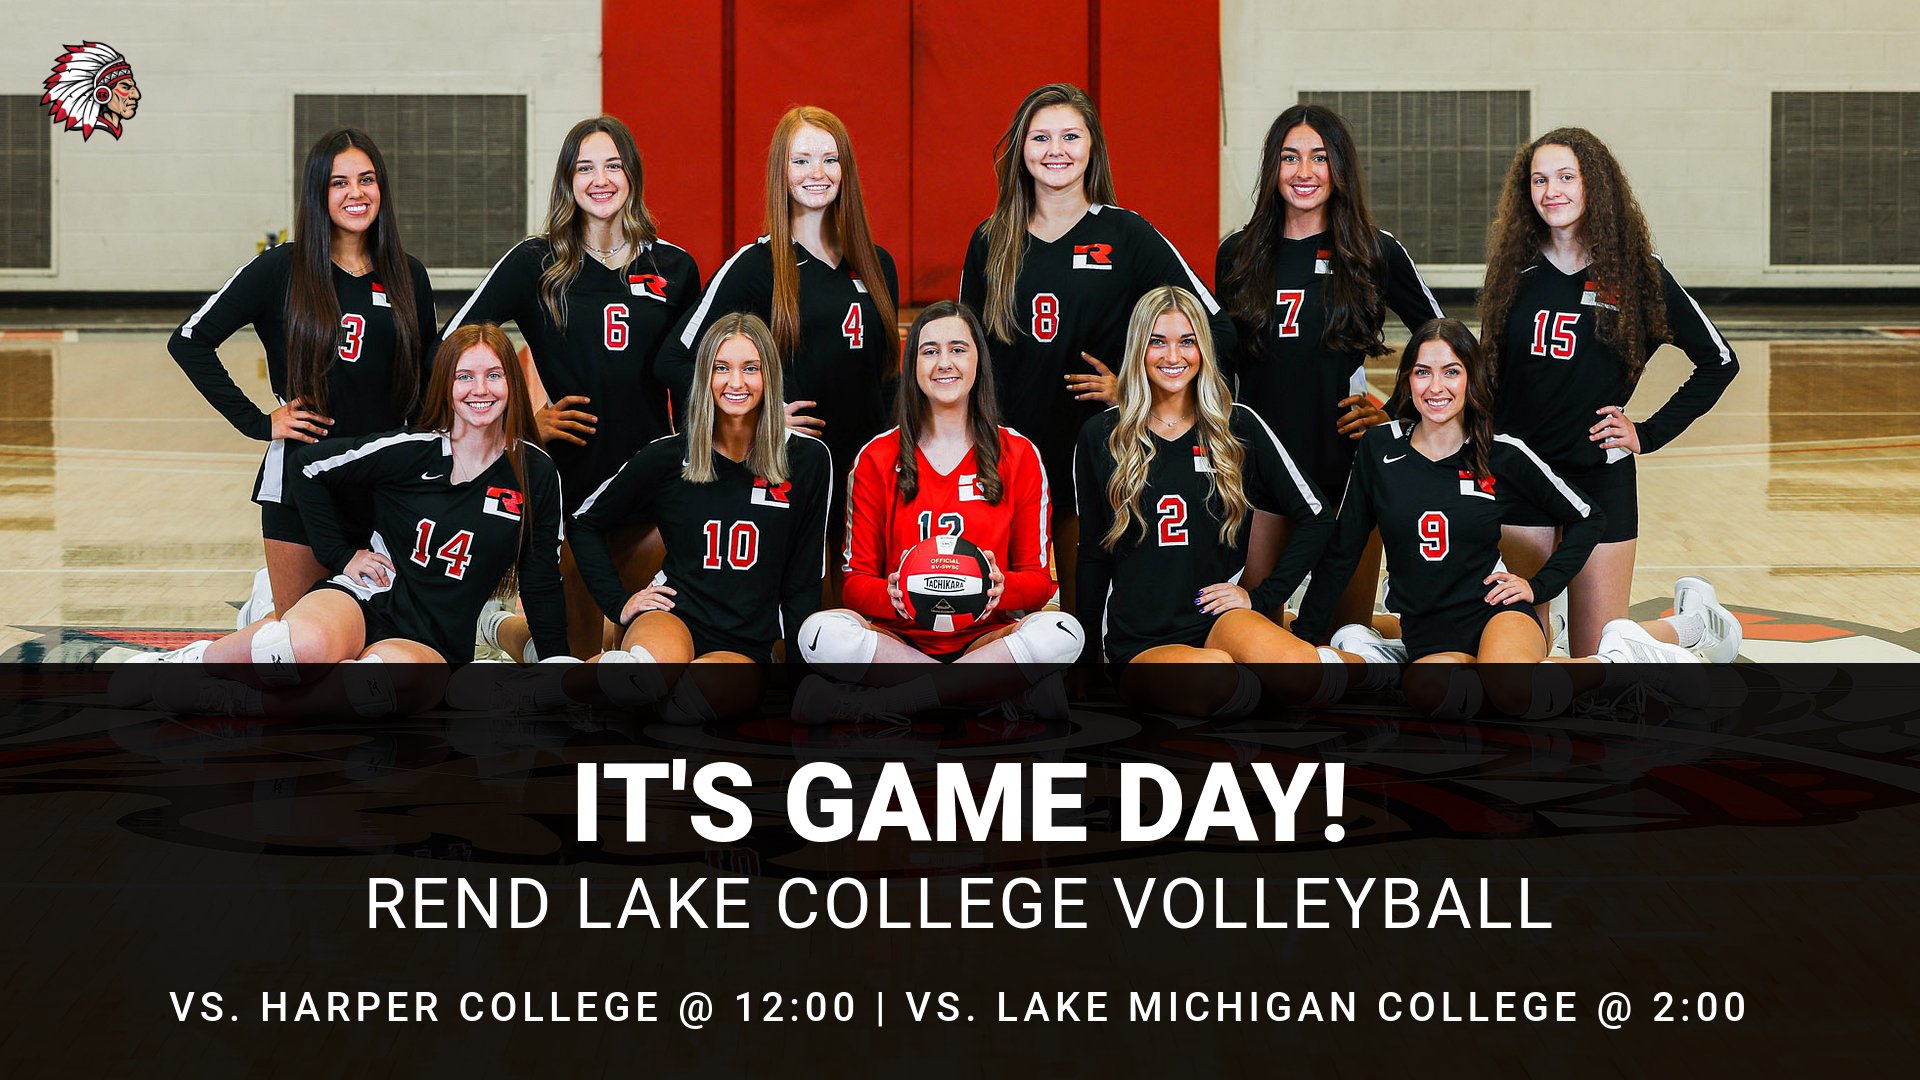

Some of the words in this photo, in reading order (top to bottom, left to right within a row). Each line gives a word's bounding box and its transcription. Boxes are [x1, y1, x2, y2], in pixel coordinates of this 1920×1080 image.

[338, 313, 366, 362] 3
[603, 303, 629, 351] 6
[842, 302, 864, 349] 4
[1032, 293, 1059, 343] 8
[1276, 289, 1304, 337] 7
[1530, 310, 1581, 360] 15
[702, 520, 760, 570] 10
[1157, 494, 1188, 546] 2
[1418, 511, 1450, 561] 9
[410, 518, 474, 581] 14
[926, 579, 964, 590] TACHIKARA
